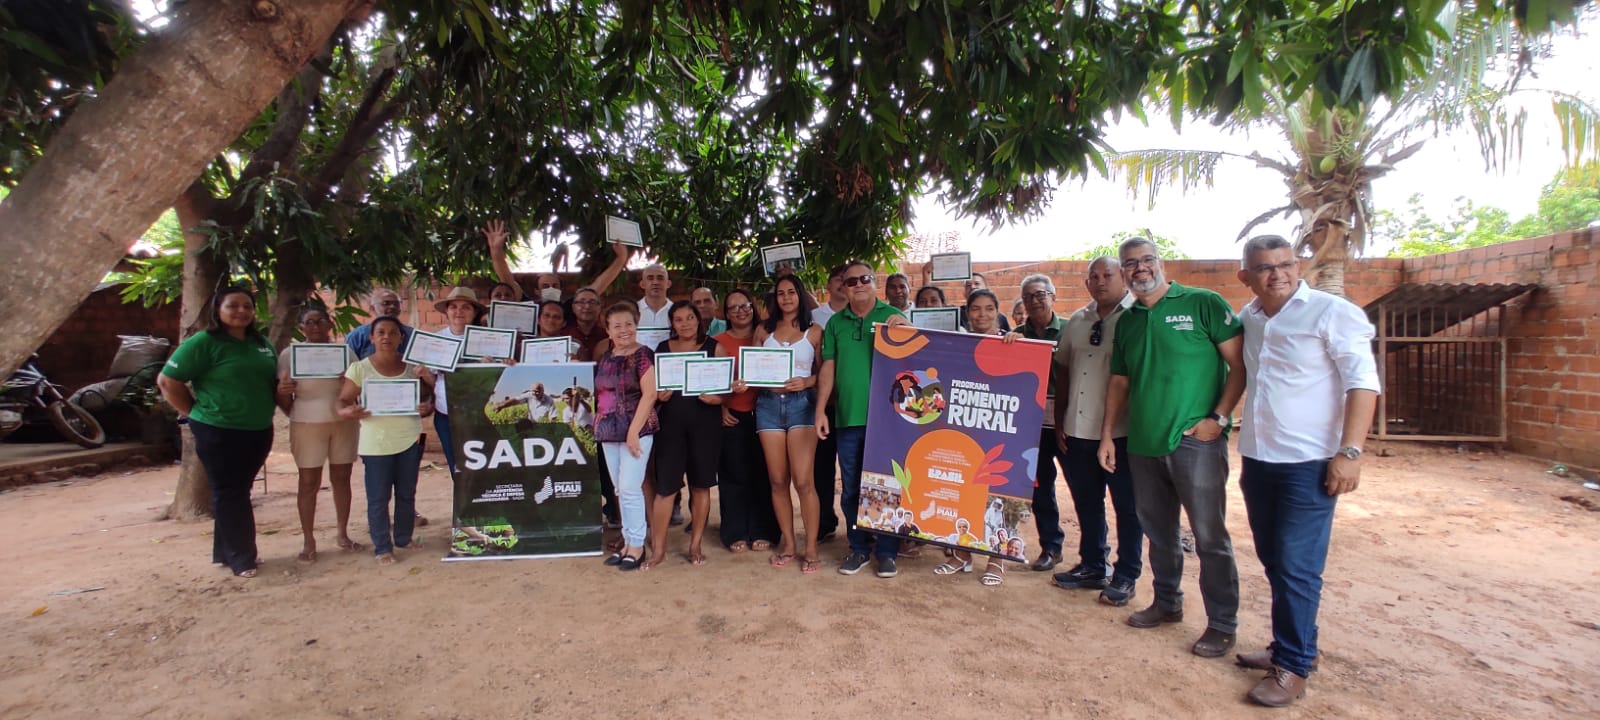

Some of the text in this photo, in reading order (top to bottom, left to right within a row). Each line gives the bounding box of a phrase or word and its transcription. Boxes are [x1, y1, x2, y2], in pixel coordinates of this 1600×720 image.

[1165, 315, 1193, 323] SADA
[951, 379, 990, 392] PROGRAMA
[950, 387, 1020, 413] FOMENTO
[947, 404, 1017, 434] RURAL
[463, 437, 587, 470] SADA
[928, 467, 965, 484] BRASIL
